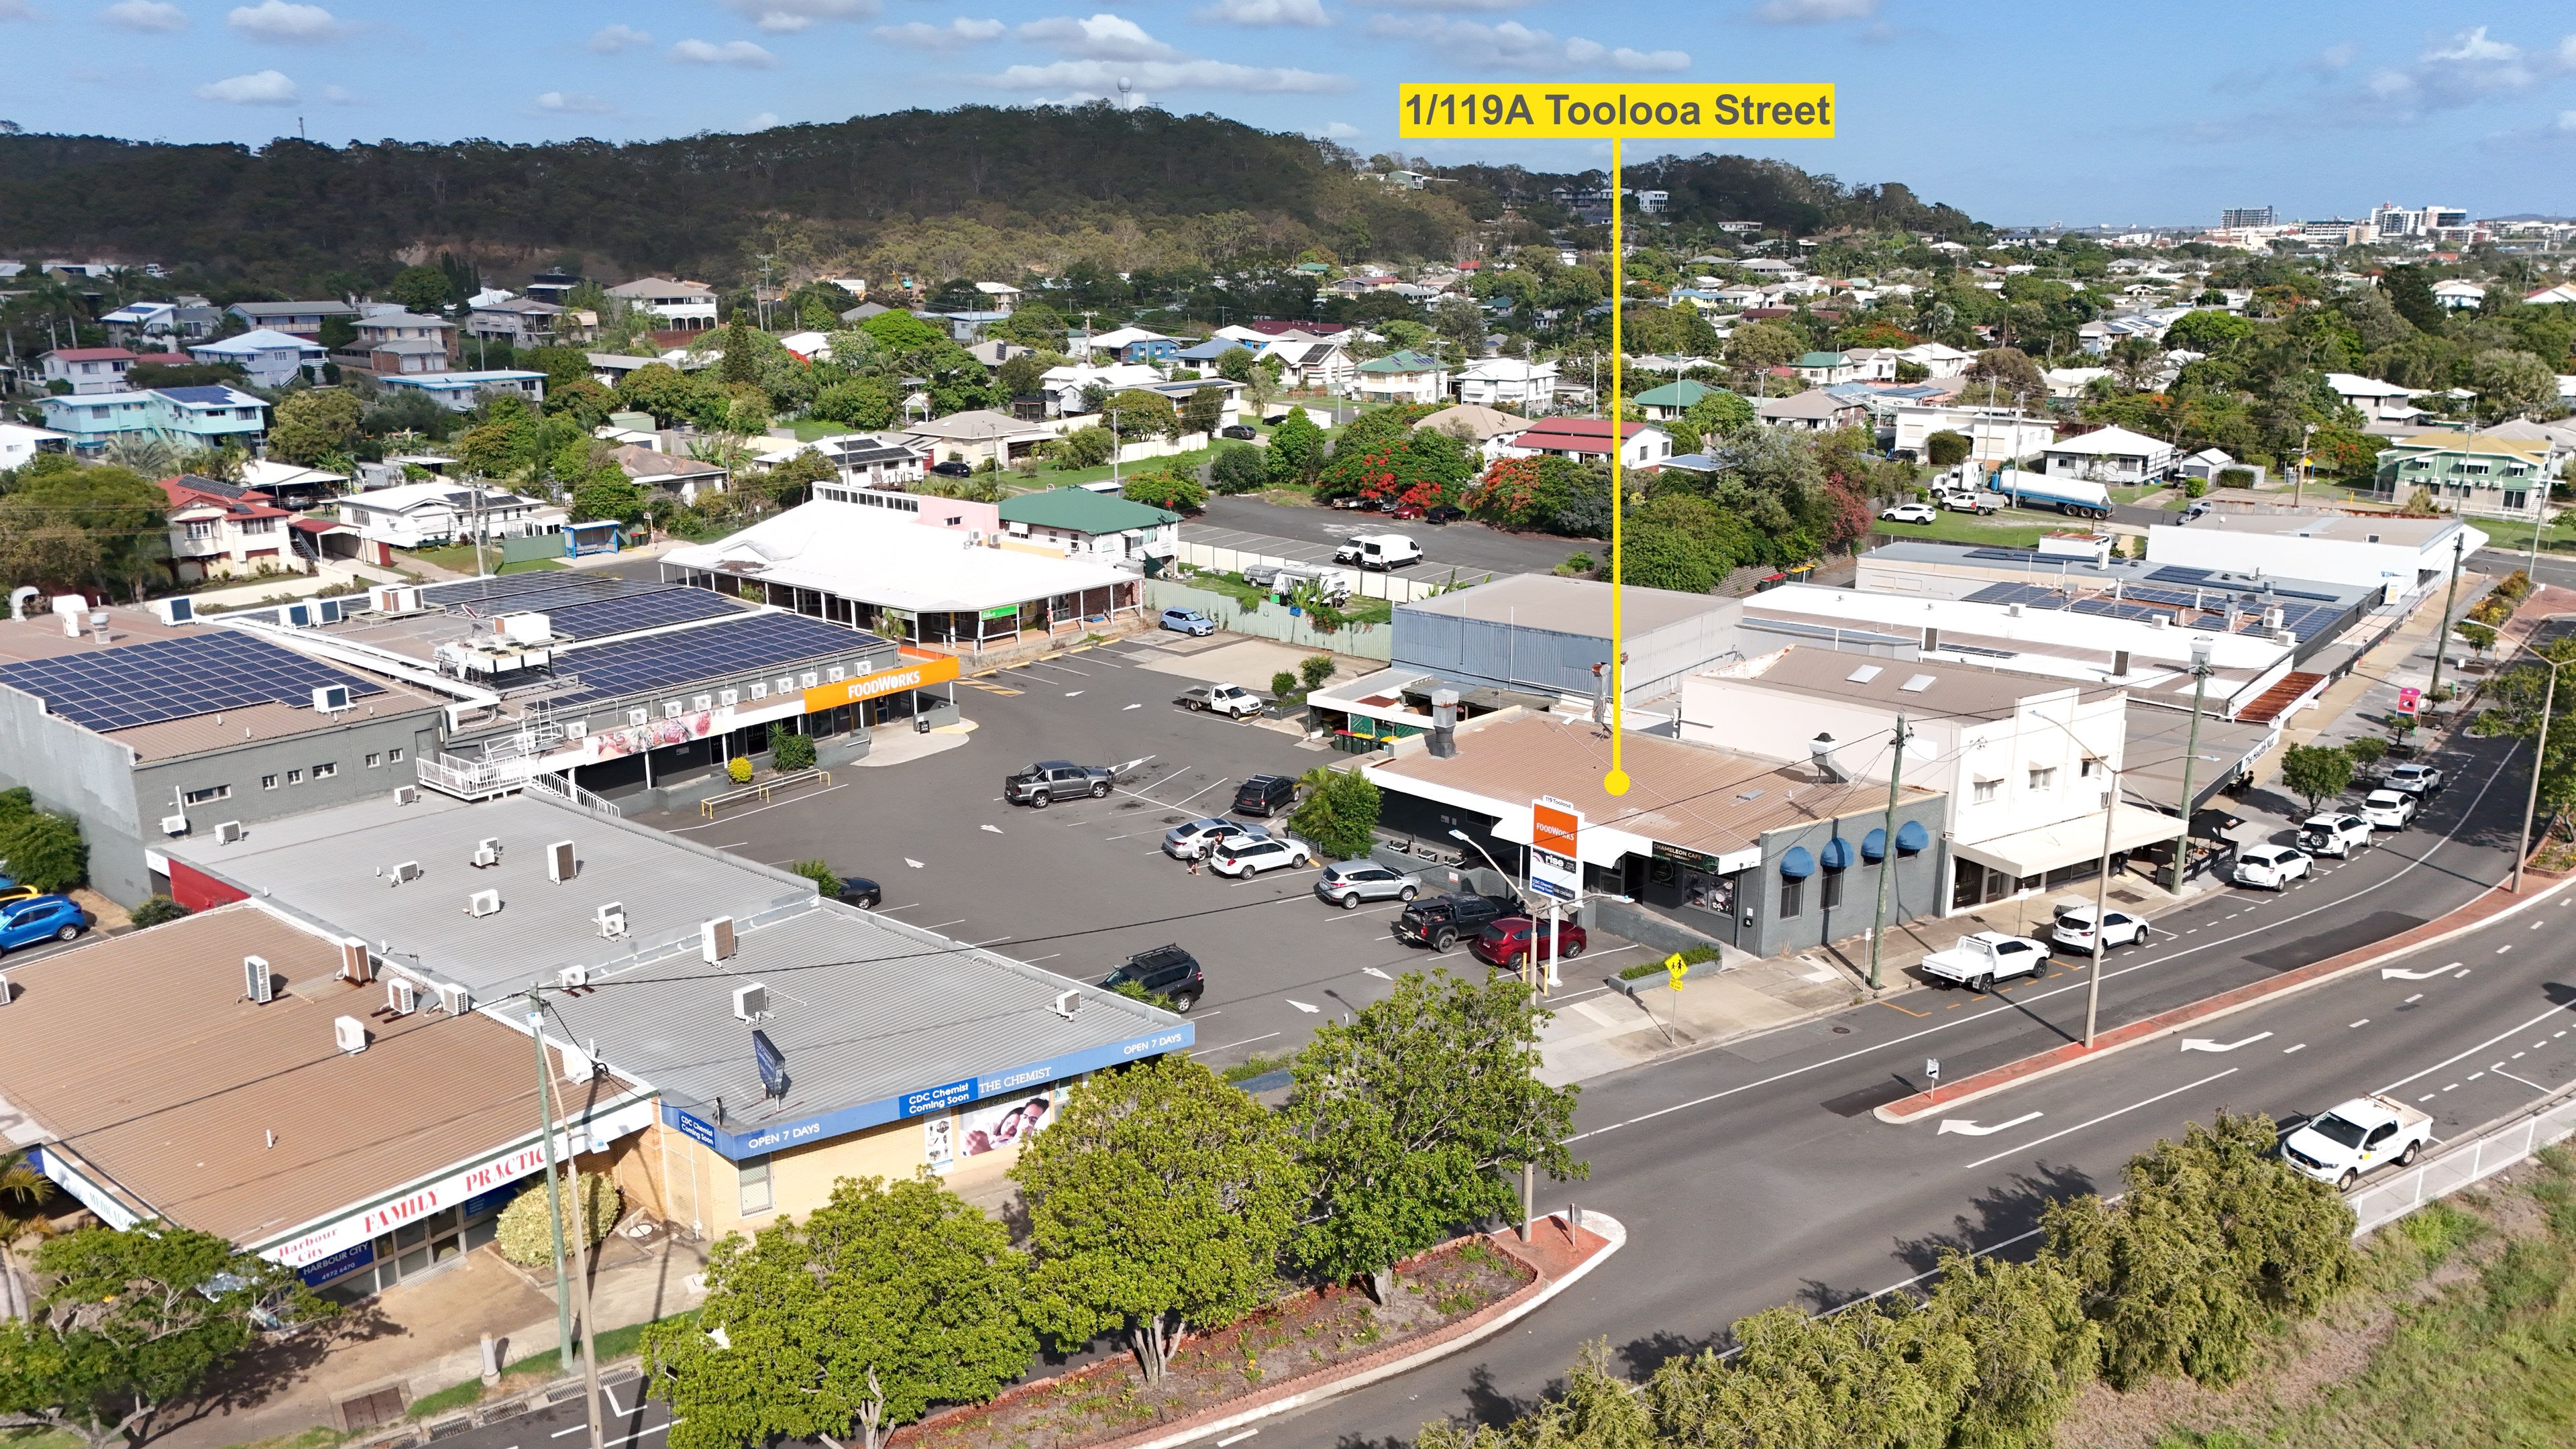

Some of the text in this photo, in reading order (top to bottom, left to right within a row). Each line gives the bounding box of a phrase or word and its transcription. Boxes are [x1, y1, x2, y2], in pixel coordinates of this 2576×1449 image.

[848, 671, 920, 699] FOODWORKS
[1553, 798, 1571, 808] Toolooa
[1536, 822, 1574, 841] FOODWORKS
[1546, 855, 1564, 867] rise
[1654, 844, 1687, 857] CHAMELEON
[1124, 1034, 1181, 1055] OPEN 7 DAYS
[979, 1067, 1052, 1093] THE CHEMIST
[909, 1082, 969, 1105] CDC Chemist
[909, 1099, 945, 1114] Coming
[947, 1092, 969, 1104] Soon
[977, 1091, 1031, 1110] WE CAN HELP
[681, 1116, 712, 1137] CDC Chemist
[682, 1124, 713, 1145] Coming Soon
[748, 1123, 820, 1149] OPEN 7 DAYS
[278, 1228, 338, 1257] Harbour
[364, 1187, 440, 1233] FAMILY
[298, 1247, 323, 1263] City
[303, 1242, 368, 1275] HARBOUR CITY
[322, 1263, 355, 1280] 4972 6470
